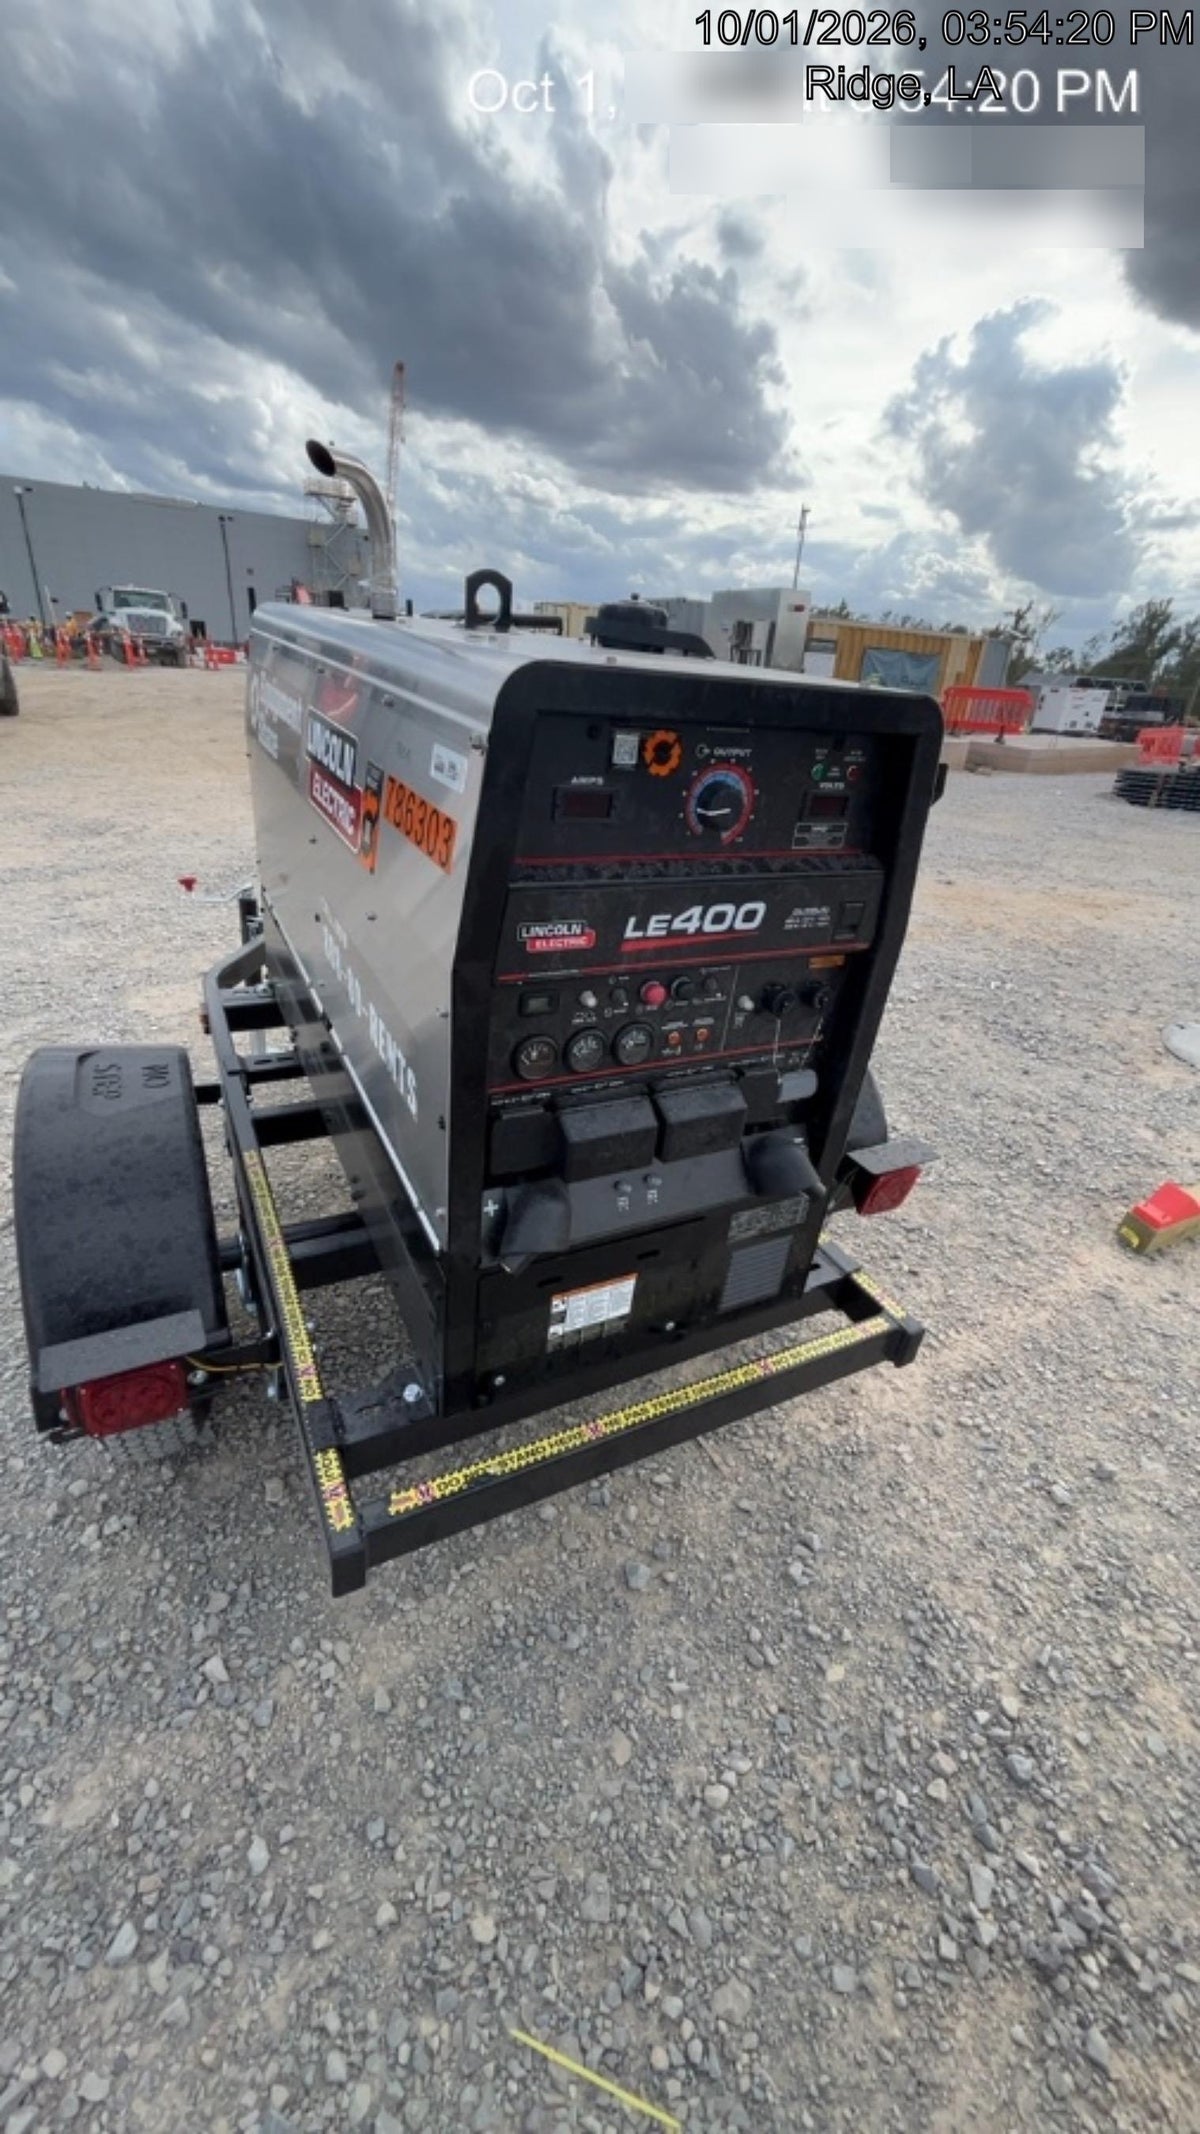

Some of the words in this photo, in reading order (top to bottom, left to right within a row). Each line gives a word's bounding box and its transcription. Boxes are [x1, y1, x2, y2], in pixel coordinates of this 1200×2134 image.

[308, 716, 355, 788] LINCOLN
[570, 776, 604, 786] AMPS
[312, 771, 355, 837] ELECTRIC
[384, 775, 452, 869] 786303
[521, 923, 583, 939] LINCOLN
[623, 901, 767, 940] LE400
[535, 935, 588, 949] ELECTRIC
[437, 1476, 462, 1492] DO
